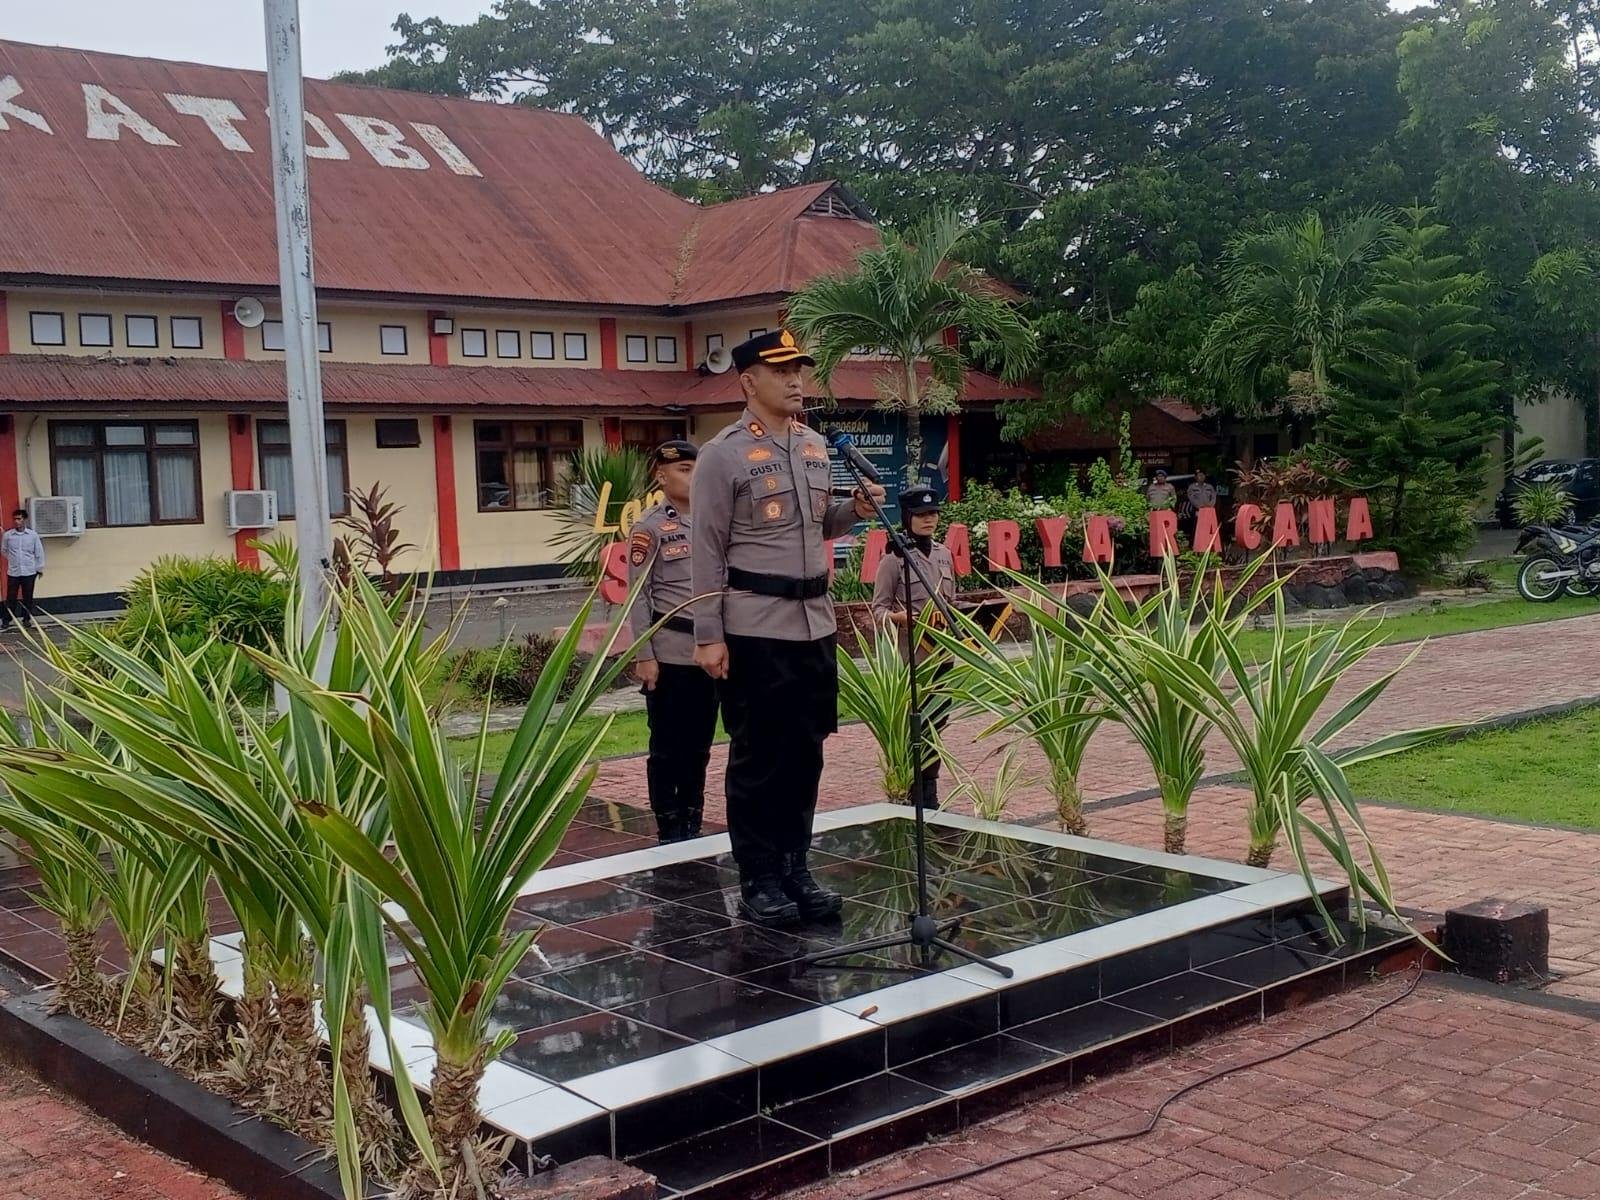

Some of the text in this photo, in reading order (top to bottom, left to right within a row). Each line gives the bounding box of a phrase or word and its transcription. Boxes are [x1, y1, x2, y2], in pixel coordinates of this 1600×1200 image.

[860, 434, 894, 446] KAPOLRI
[750, 463, 783, 477] GUSTI
[1149, 497, 1374, 557] RACANA
